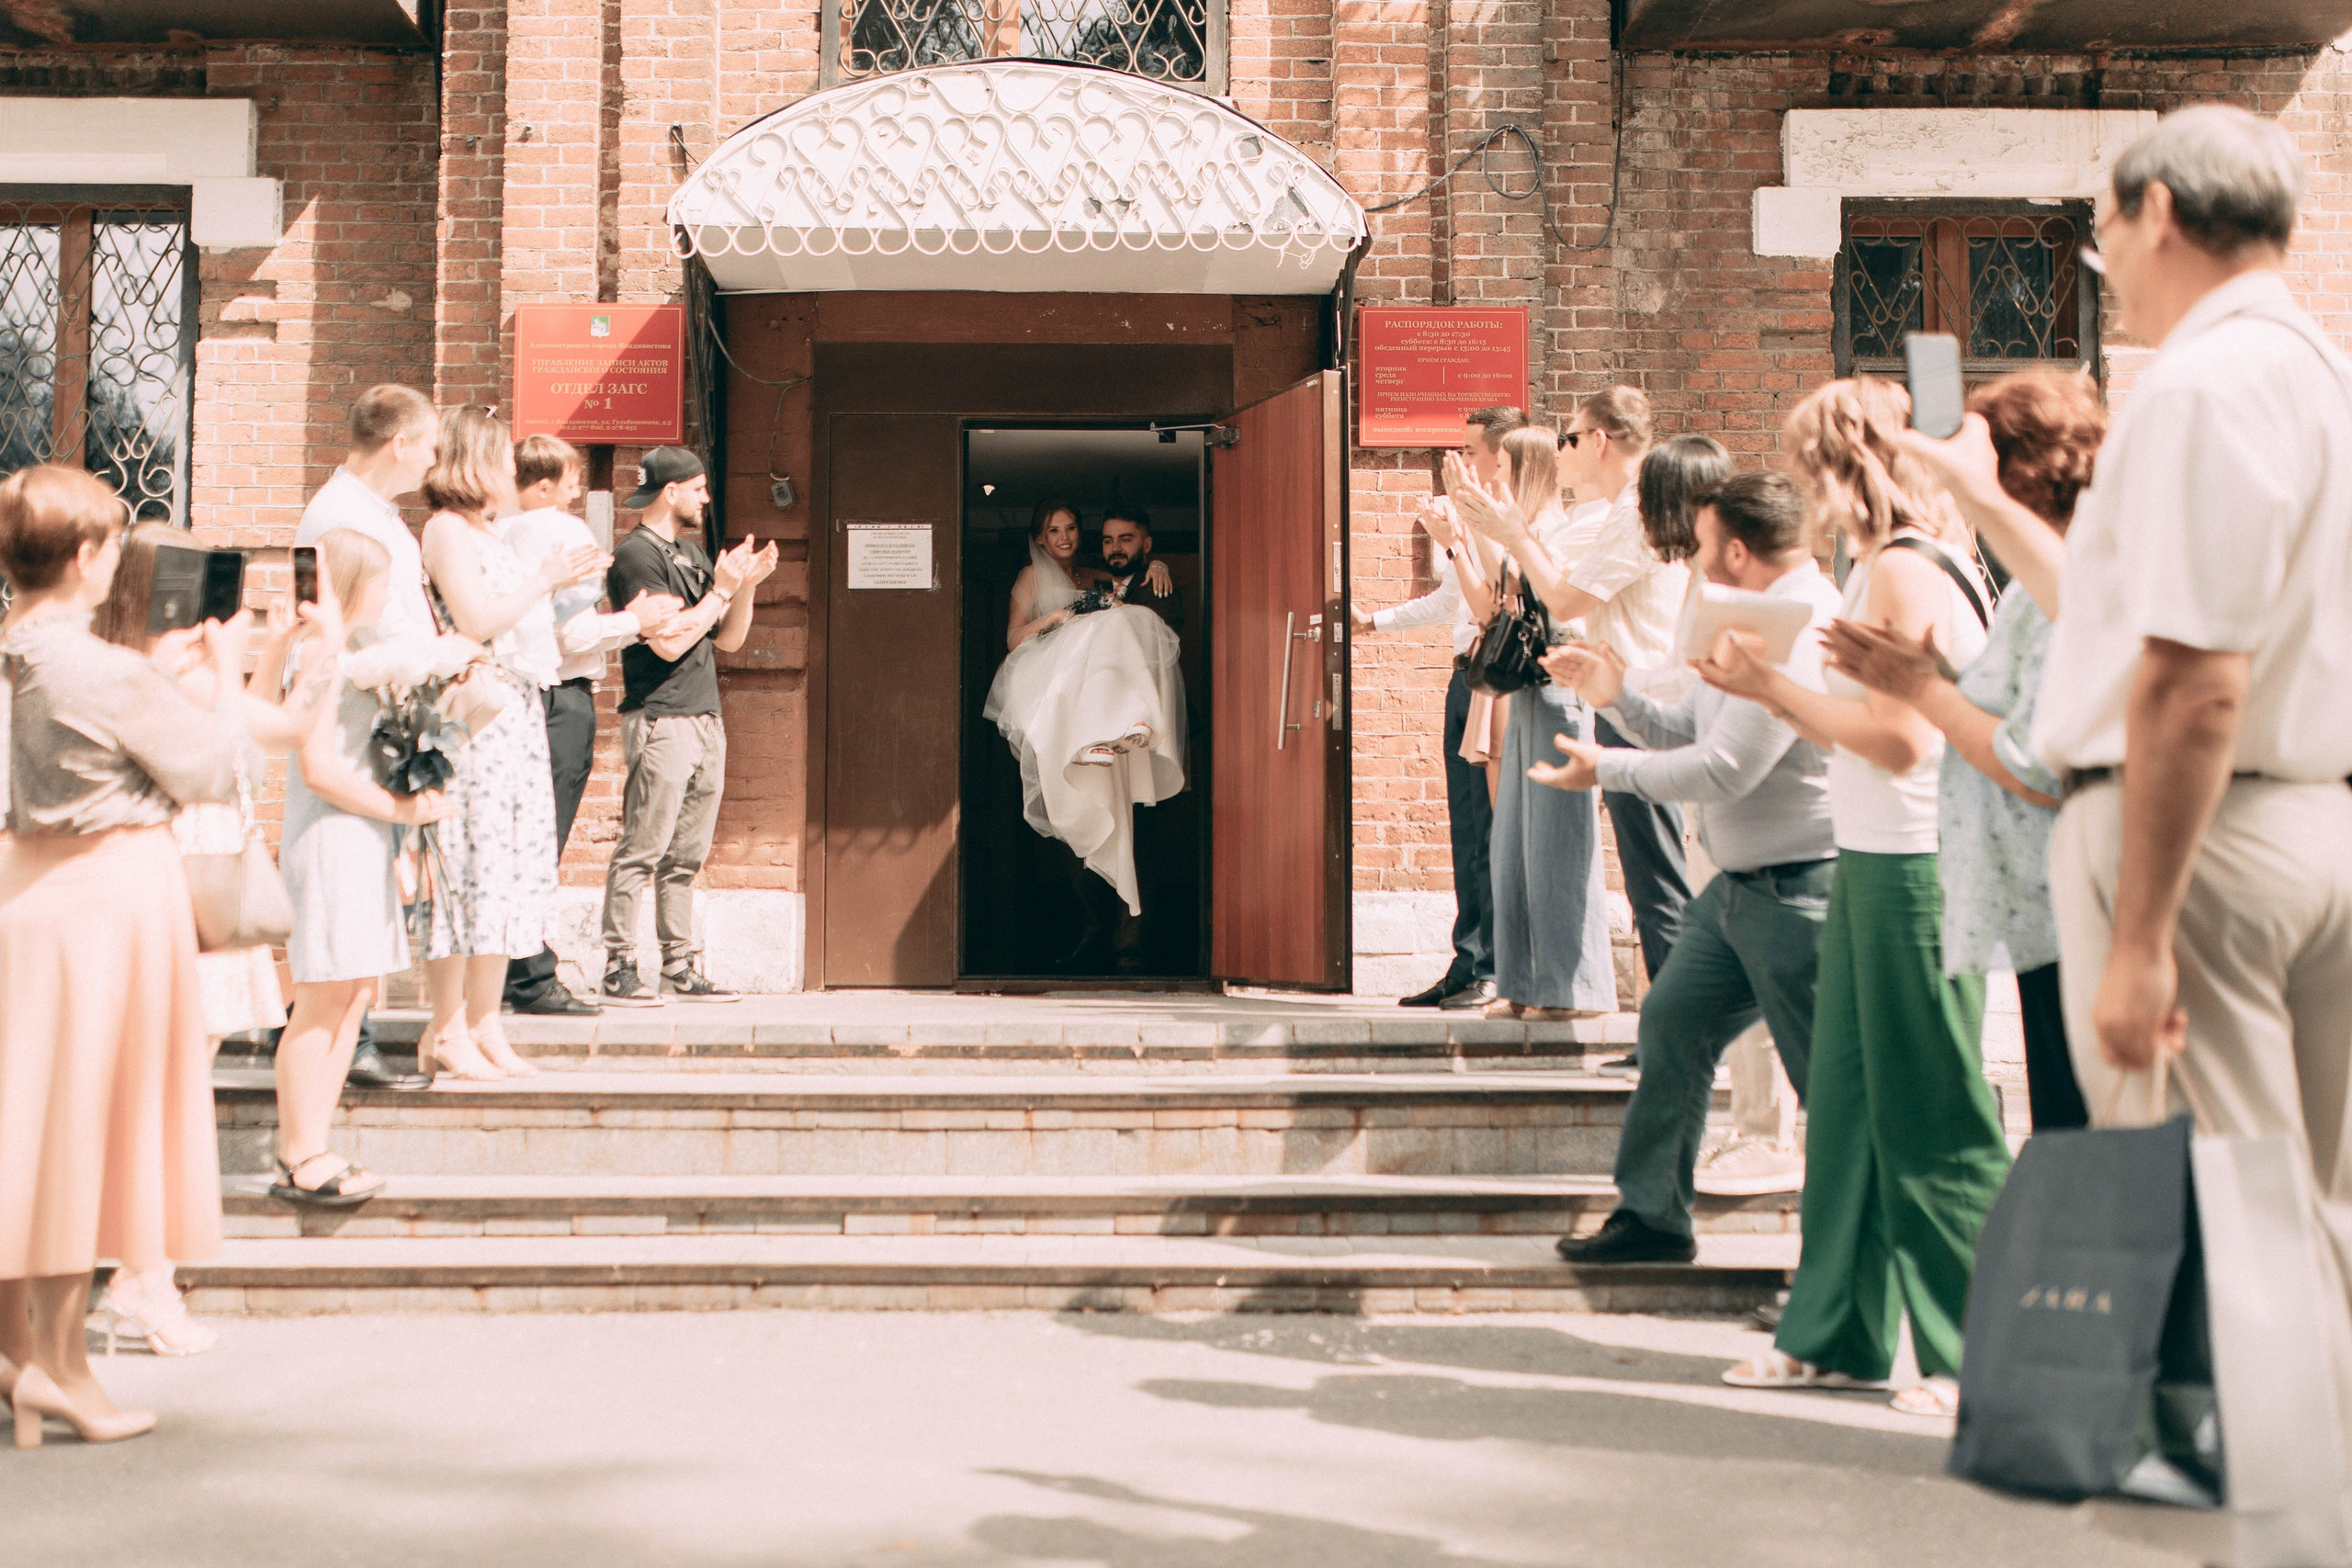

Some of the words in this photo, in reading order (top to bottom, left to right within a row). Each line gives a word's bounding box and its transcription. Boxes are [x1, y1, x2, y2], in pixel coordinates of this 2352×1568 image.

[1385, 321, 1454, 329] РАСПОРЯДОК
[1456, 321, 1503, 329] РАБОТЫ:
[550, 382, 605, 396] ОТДЕЛ
[607, 382, 648, 395] ЗАГС
[604, 397, 613, 410] 1
